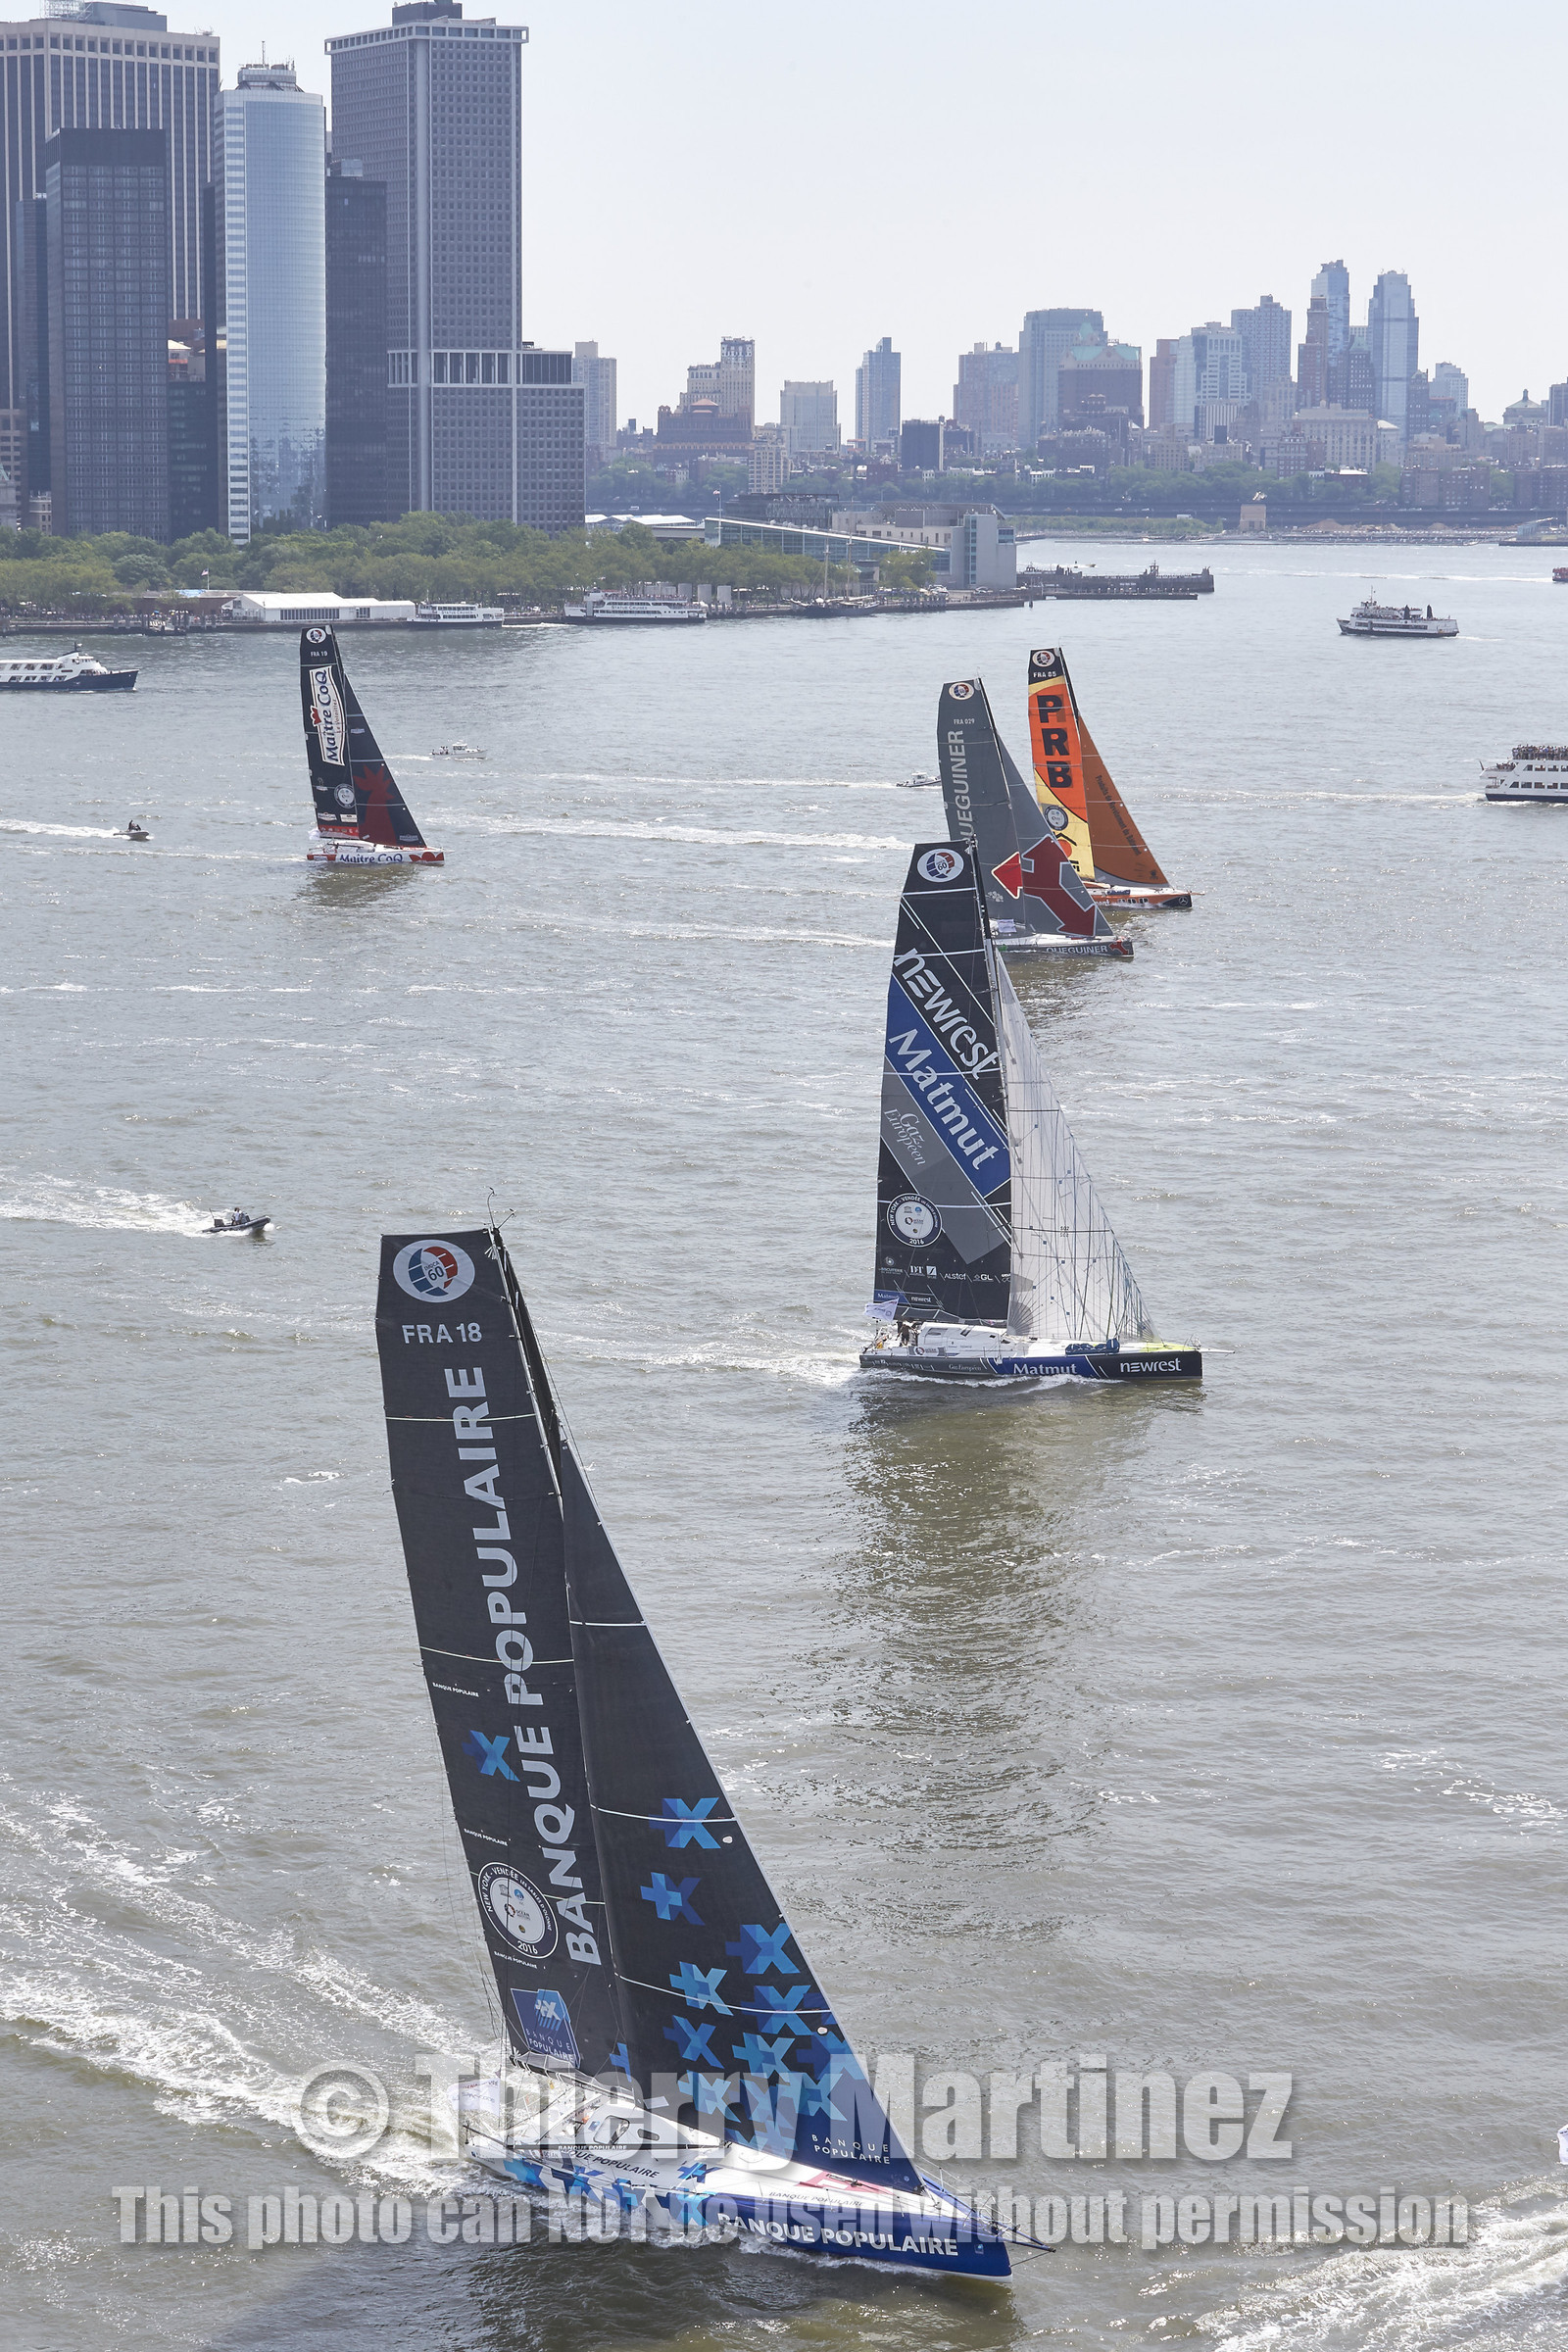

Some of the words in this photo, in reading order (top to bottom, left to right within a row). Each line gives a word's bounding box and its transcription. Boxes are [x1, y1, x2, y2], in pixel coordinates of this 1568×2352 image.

[315, 669, 332, 707] CoQ
[1037, 695, 1073, 789] PRB
[948, 730, 975, 841] UEGUINER
[938, 862, 948, 871] 60
[894, 948, 1000, 1080] newrest
[889, 1029, 999, 1170] Matmut
[884, 1108, 926, 1165] Européen
[900, 1113, 925, 1146] Gaz
[428, 1266, 444, 1281] 60
[402, 1323, 454, 1345] FRA
[456, 1322, 482, 1343] 18
[1013, 1363, 1077, 1375] Matmut
[1120, 1357, 1182, 1372] newrest
[444, 1366, 544, 1706] POPULAIRE
[514, 1725, 602, 1966] BANQUE
[516, 1940, 538, 1955] 2016
[525, 2028, 571, 2051] BANQUE
[528, 2037, 575, 2063] POPULAIRE
[811, 2133, 889, 2154] BANQUE
[814, 2144, 891, 2165] POPULAIRE
[592, 2156, 661, 2179] POPULAIRE
[769, 2191, 810, 2200] BANQUE
[812, 2196, 863, 2206] POPULAIRE
[717, 2213, 815, 2243] BANQUE
[820, 2228, 958, 2256] POPULAIRE
